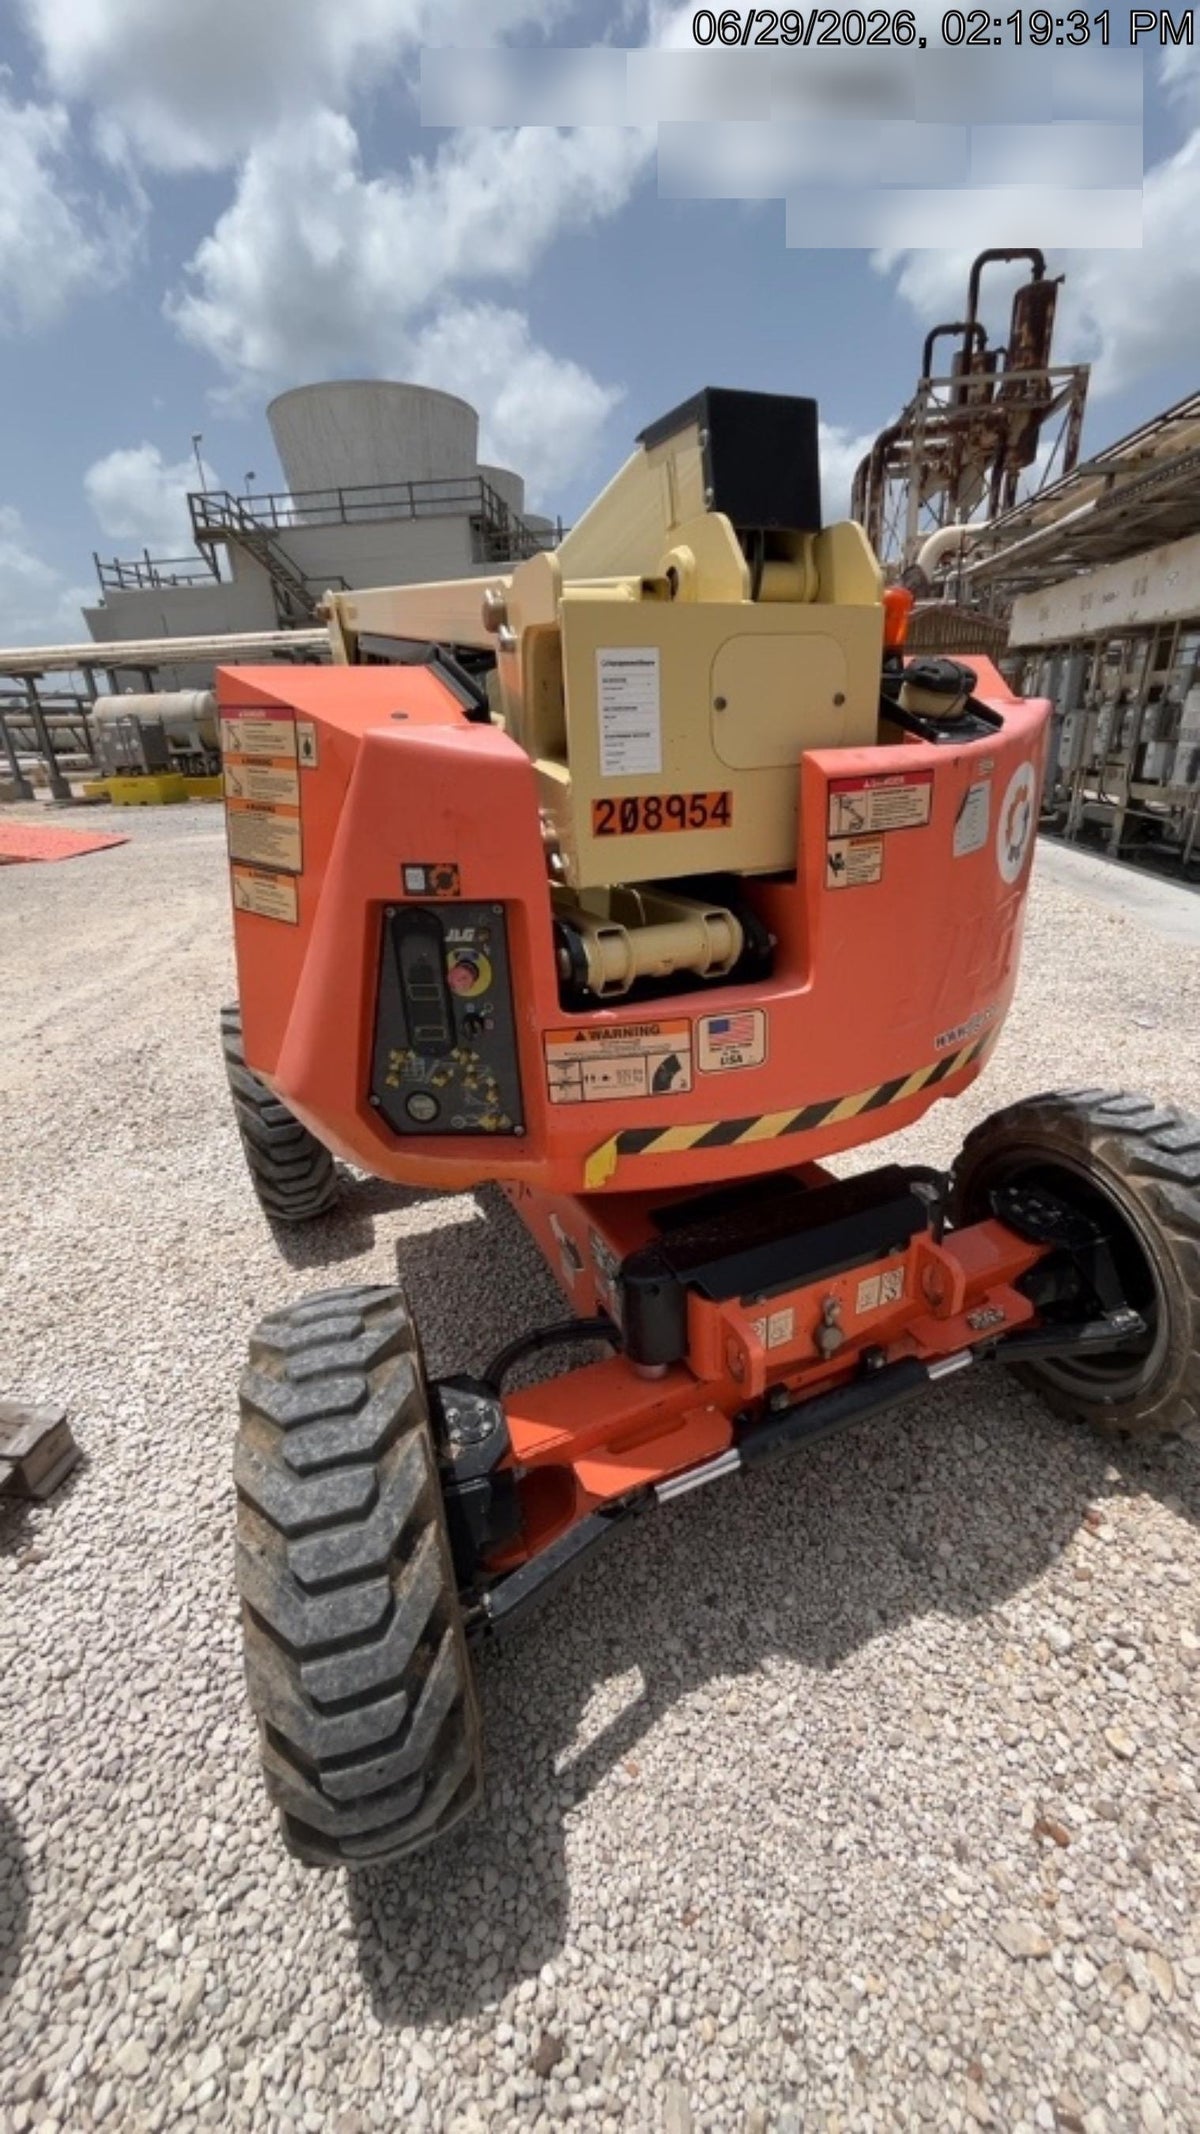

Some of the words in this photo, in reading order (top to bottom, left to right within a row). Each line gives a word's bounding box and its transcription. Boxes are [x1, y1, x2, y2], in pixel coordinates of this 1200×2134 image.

[595, 791, 731, 836] 208954
[445, 928, 475, 942] JLG
[589, 1023, 661, 1040] WARNING
[720, 1054, 743, 1066] USA
